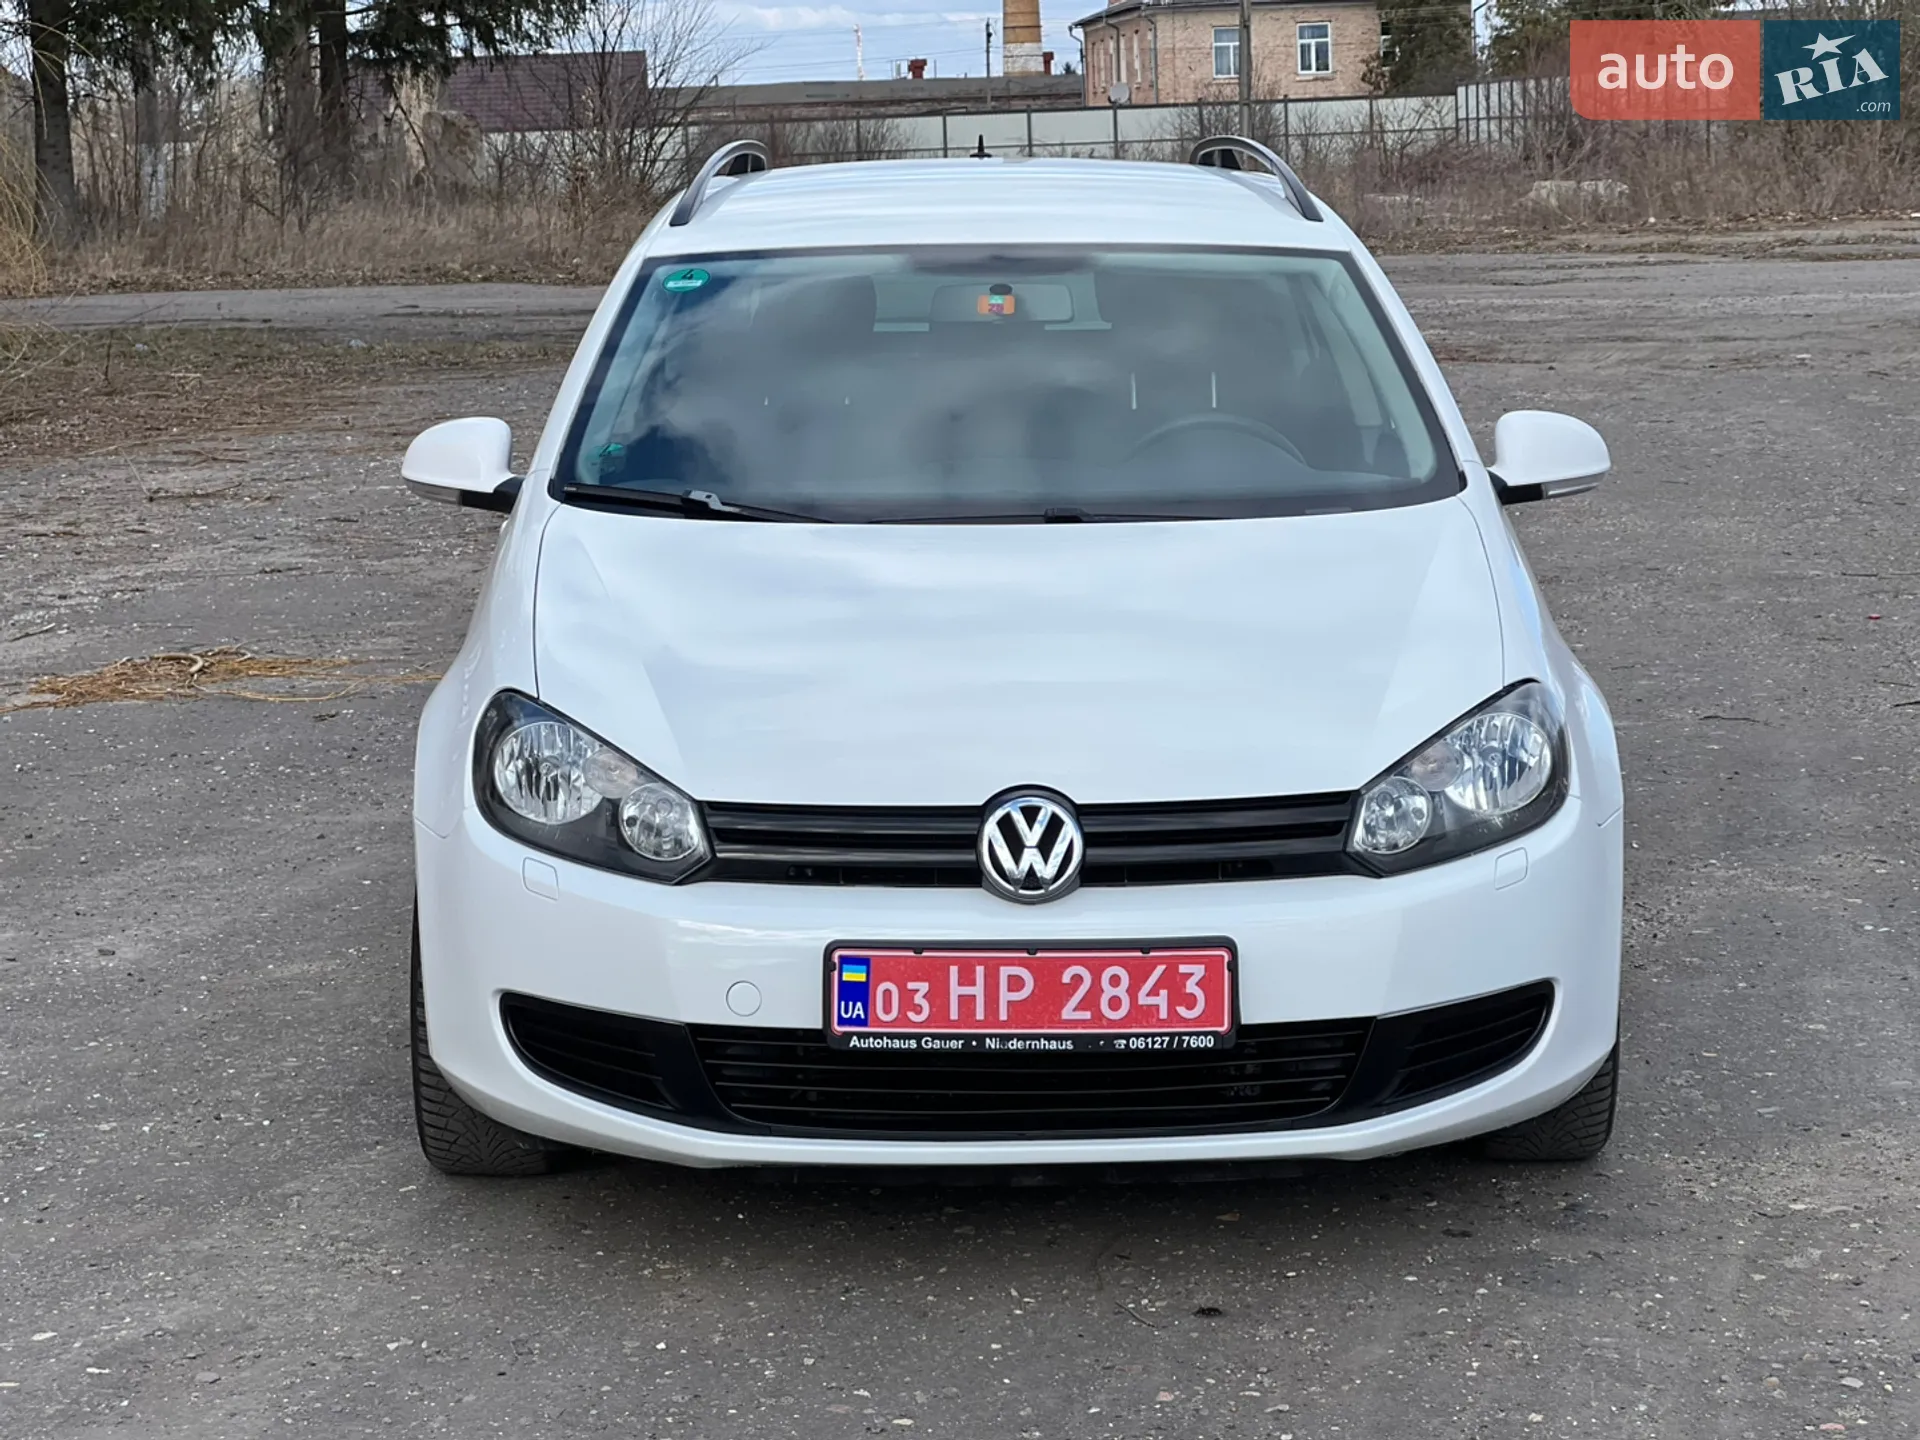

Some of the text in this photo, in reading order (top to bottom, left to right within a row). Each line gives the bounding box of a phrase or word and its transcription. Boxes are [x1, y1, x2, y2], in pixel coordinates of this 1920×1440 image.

[875, 964, 1206, 1023] 03 HP 2843
[840, 1001, 866, 1020] UA
[849, 1035, 917, 1049] Autohaus
[921, 1036, 965, 1050] Gauer
[1129, 1037, 1170, 1050] 06127
[1182, 1035, 1215, 1049] 7600
